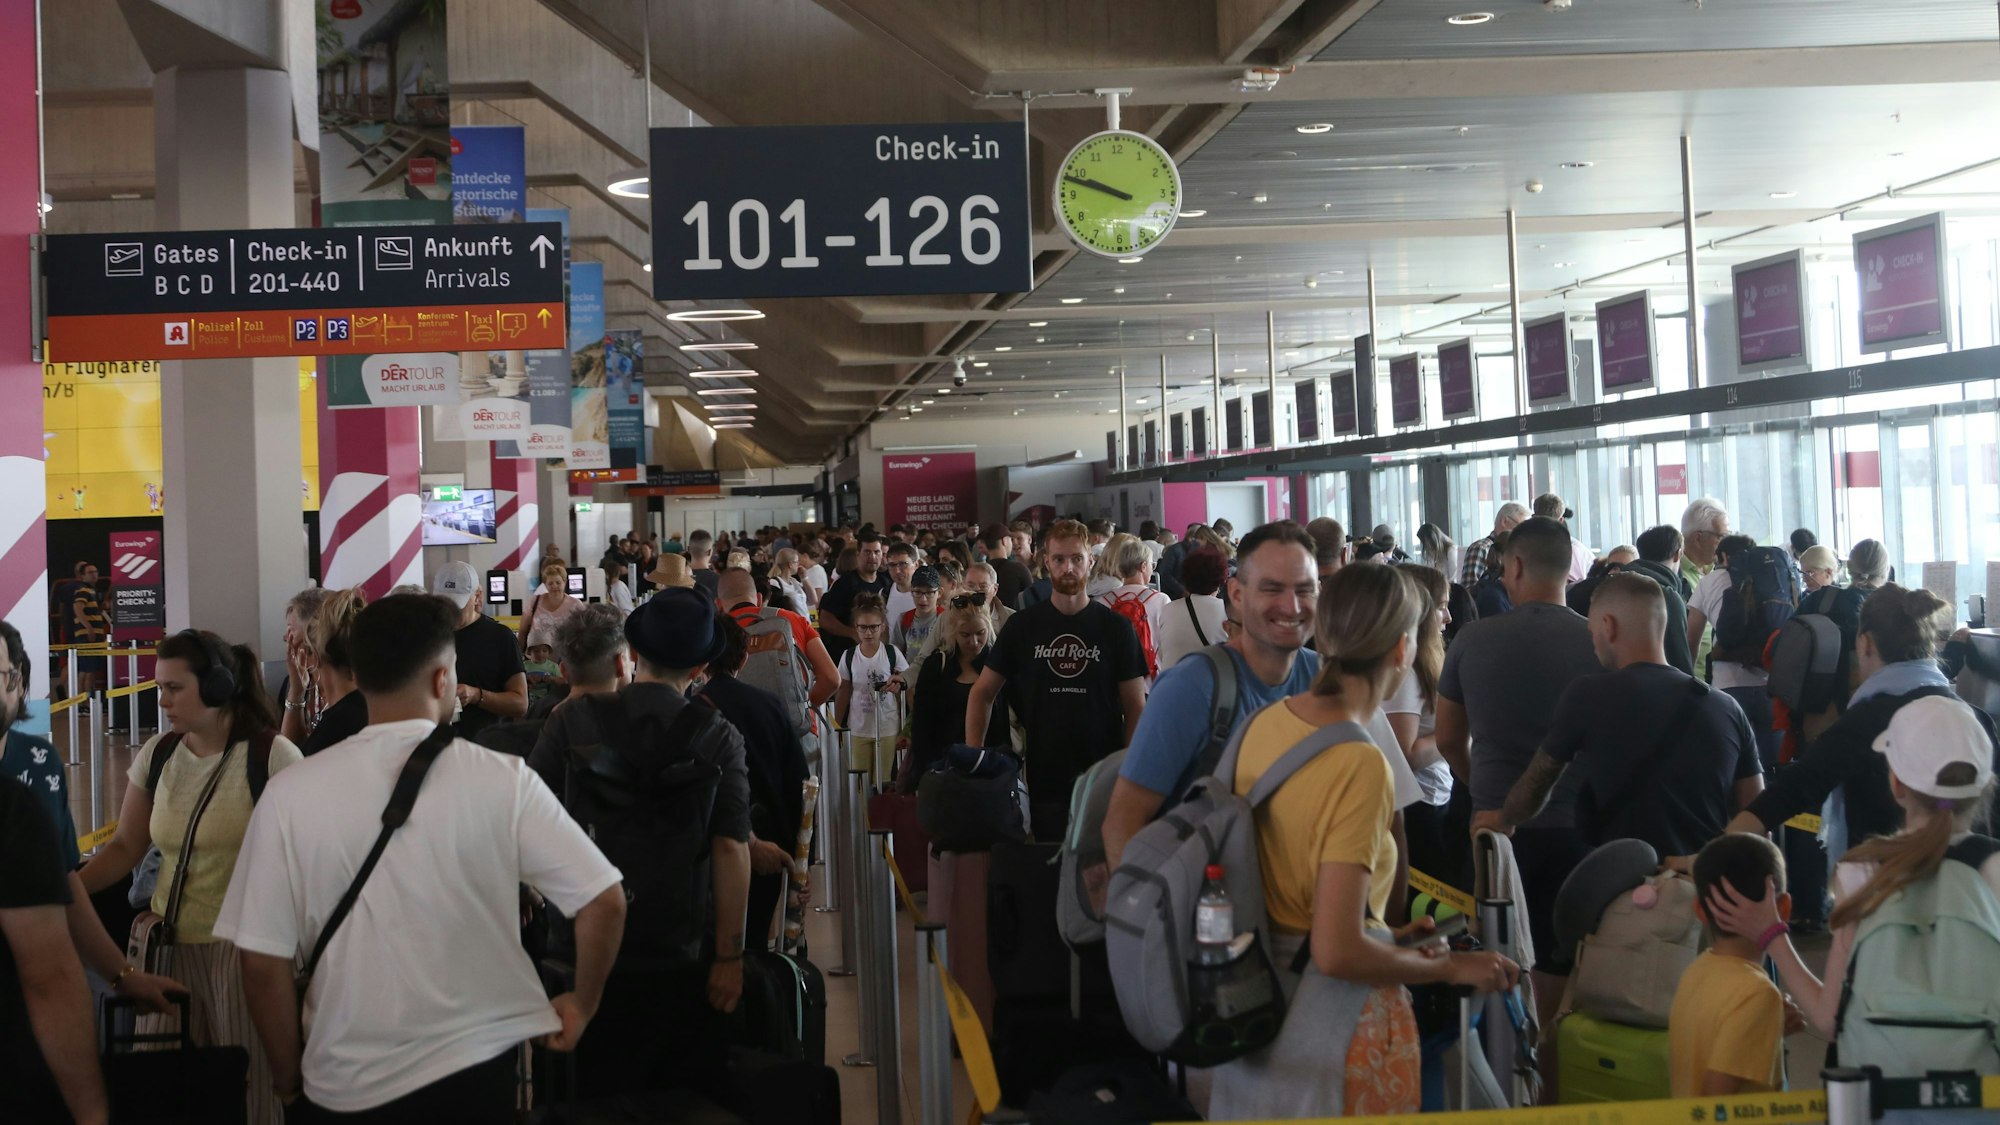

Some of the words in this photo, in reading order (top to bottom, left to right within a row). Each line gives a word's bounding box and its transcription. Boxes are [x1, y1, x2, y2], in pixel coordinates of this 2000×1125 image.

[875, 134, 999, 160] Check-in
[1112, 145, 1123, 154] 12
[1091, 153, 1101, 161] 11
[1137, 152, 1142, 160] 1
[1075, 169, 1086, 177] 10
[1153, 168, 1159, 177] 2
[453, 187, 518, 200] storische
[1070, 190, 1077, 199] 9
[1160, 189, 1166, 198] 3
[454, 203, 504, 217] Stätten
[1152, 210, 1159, 219] 4
[1078, 212, 1084, 221] 8
[683, 195, 1001, 270] 101-126
[1093, 229, 1099, 238] 7
[1140, 229, 1146, 238] 5
[1116, 234, 1122, 243] 6
[248, 240, 347, 262] Check-in
[425, 236, 513, 257] Ankunft
[154, 244, 219, 264] Gates
[249, 271, 340, 293] 201-440
[426, 267, 511, 288] Arrivals
[155, 275, 168, 295] B
[178, 275, 190, 294] C
[201, 275, 213, 294] D
[417, 312, 459, 321] Konferenz-
[472, 315, 493, 324] Taxi
[199, 321, 234, 332] Polizei
[244, 321, 264, 331] Zoll
[418, 320, 449, 328] zentrum
[199, 334, 229, 345] Police
[244, 333, 286, 344] Customs
[381, 365, 444, 380] DERTOUR
[1848, 369, 1862, 388] 115
[1726, 387, 1738, 403] 114
[474, 410, 520, 421] DERTOUR
[117, 590, 156, 598] PRIORITY-
[117, 598, 155, 606] CHECK-IN
[1034, 644, 1067, 659] Hard
[1069, 644, 1100, 661] Rock
[1734, 1104, 1764, 1118] Köln
[1770, 1102, 1803, 1116] Bonn
